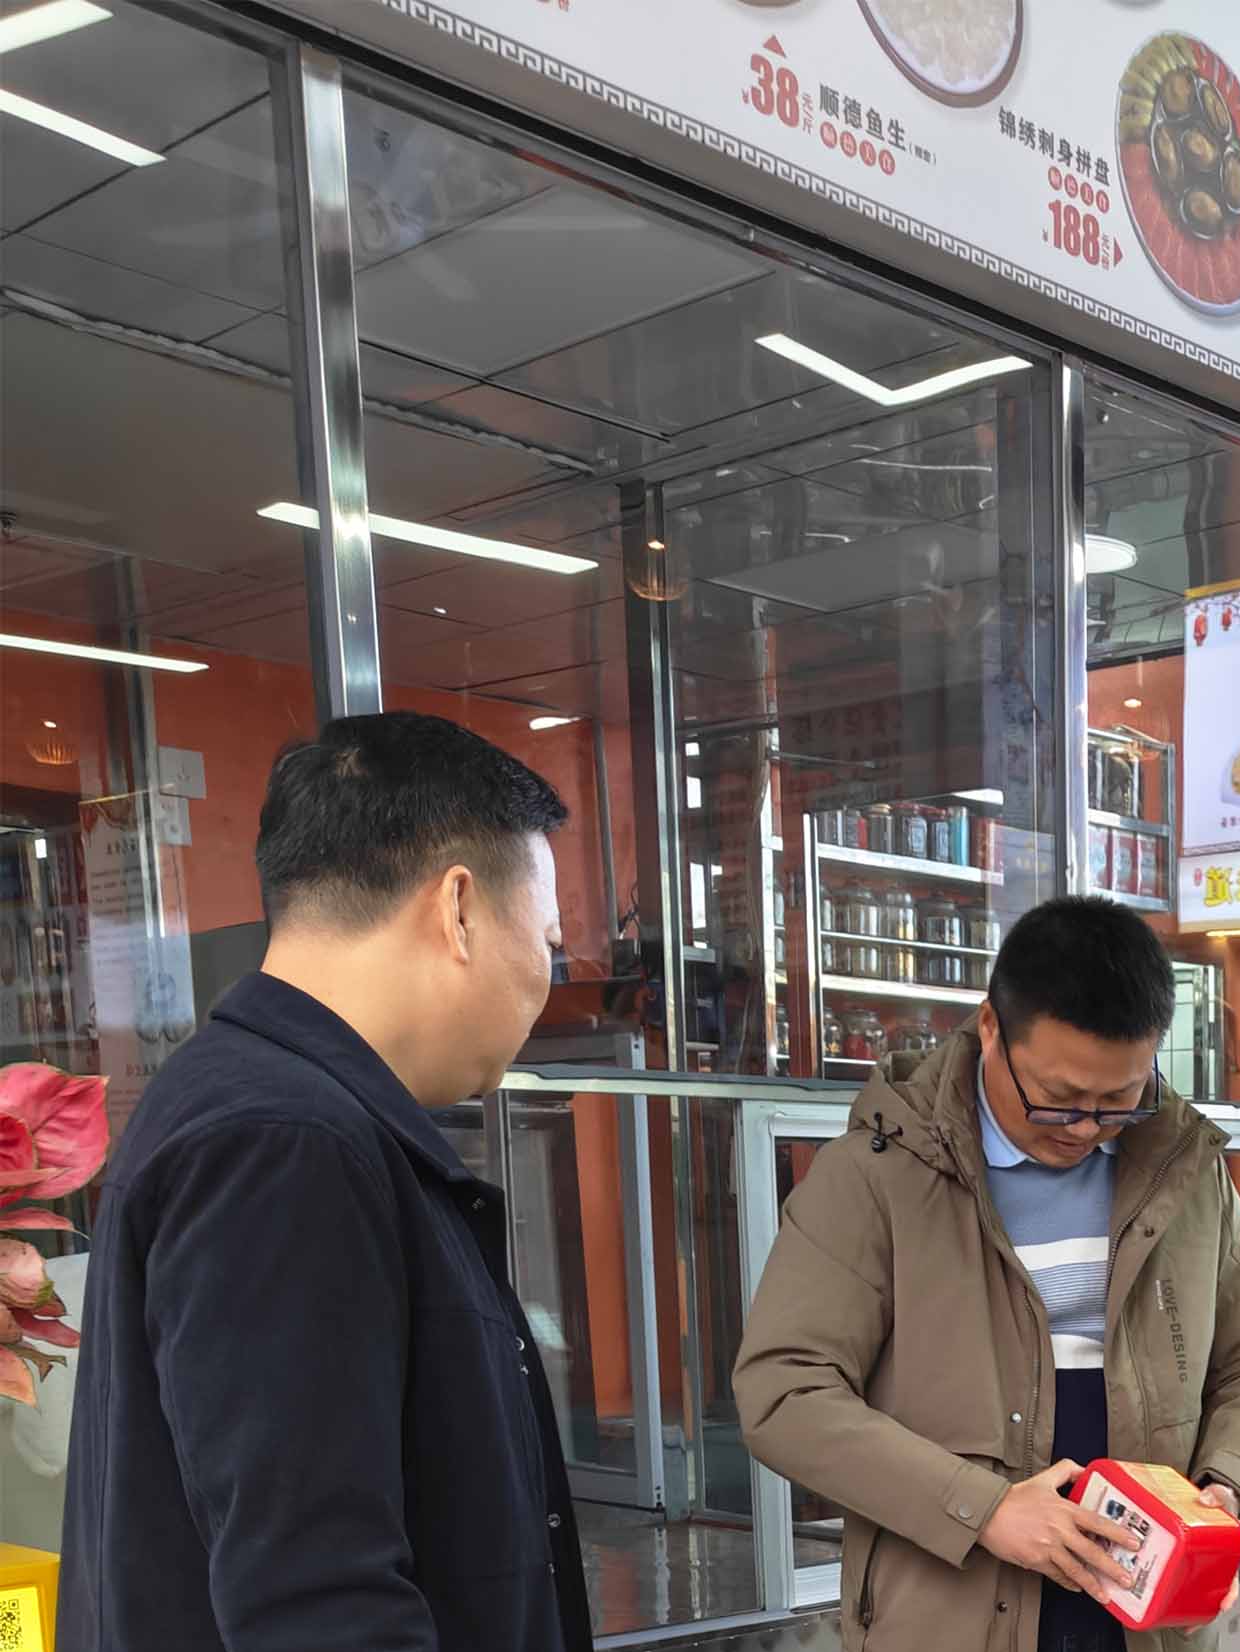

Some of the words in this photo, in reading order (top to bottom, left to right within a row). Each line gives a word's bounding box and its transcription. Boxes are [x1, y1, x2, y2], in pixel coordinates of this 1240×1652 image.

[820, 83, 906, 152] 顺德鱼生
[998, 105, 1110, 186] 锦绣刺身拼盘
